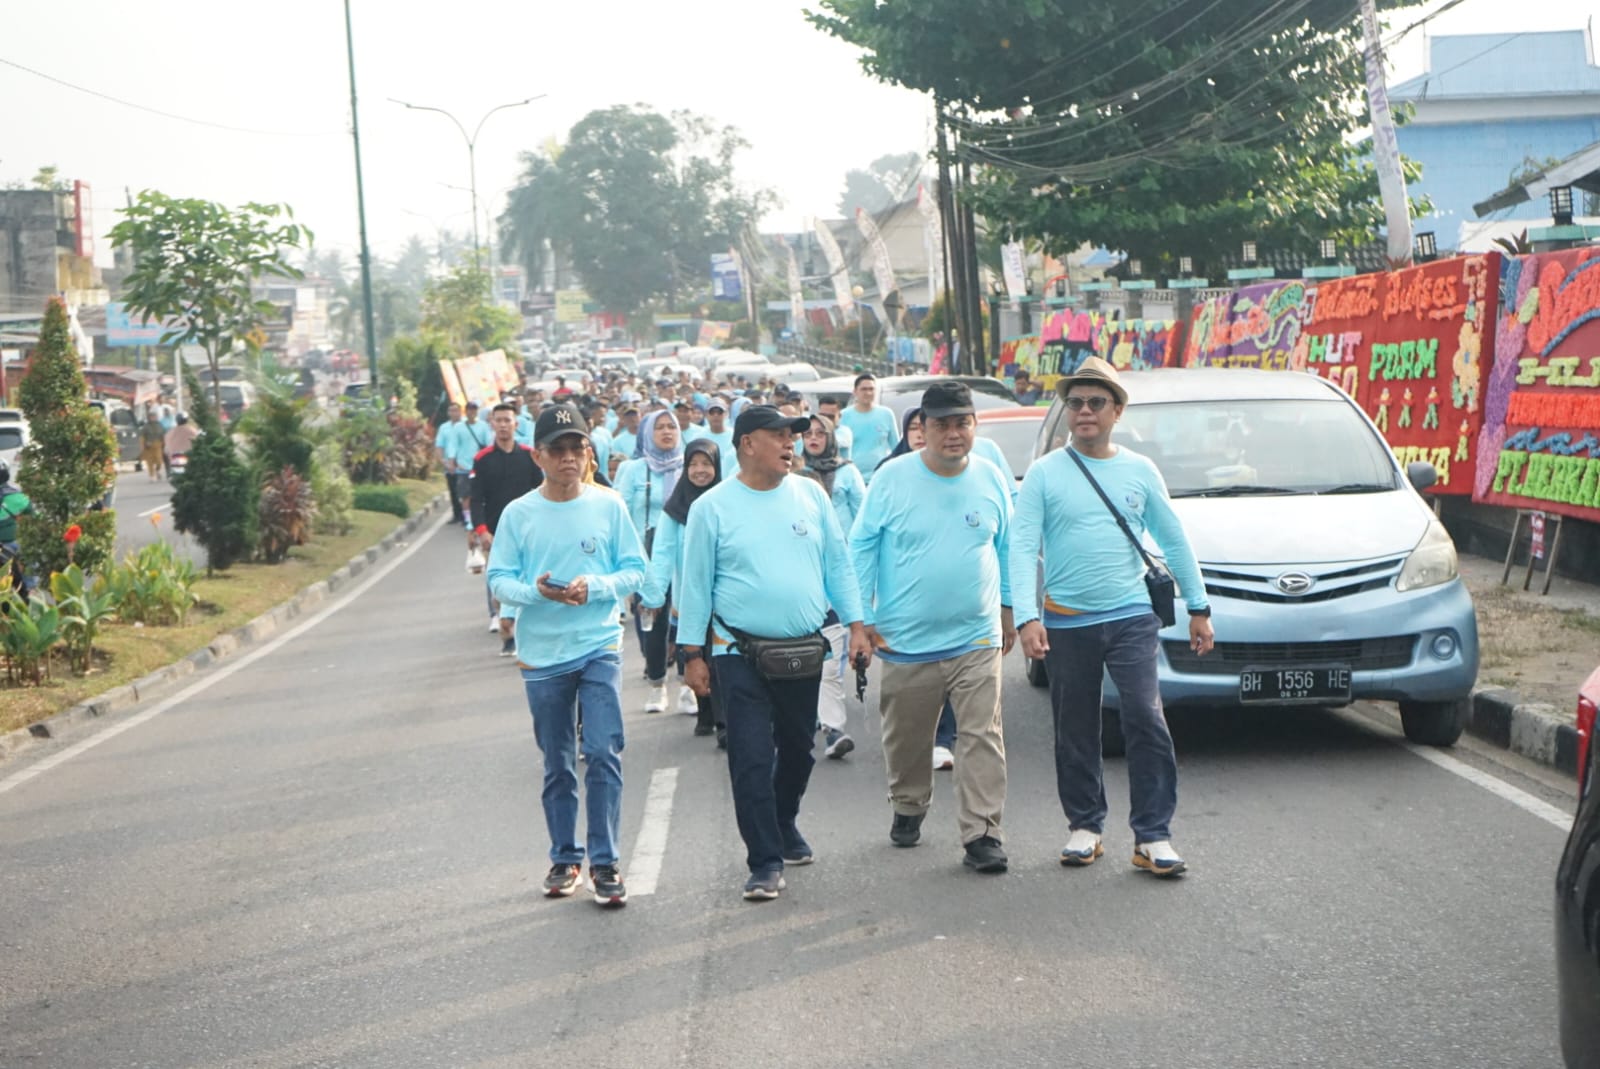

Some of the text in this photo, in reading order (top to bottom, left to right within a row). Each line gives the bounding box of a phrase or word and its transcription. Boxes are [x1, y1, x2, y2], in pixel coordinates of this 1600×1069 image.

[1308, 331, 1362, 363] HUT
[1369, 338, 1439, 381] PDAM
[1242, 669, 1348, 692] BH 1556 HE
